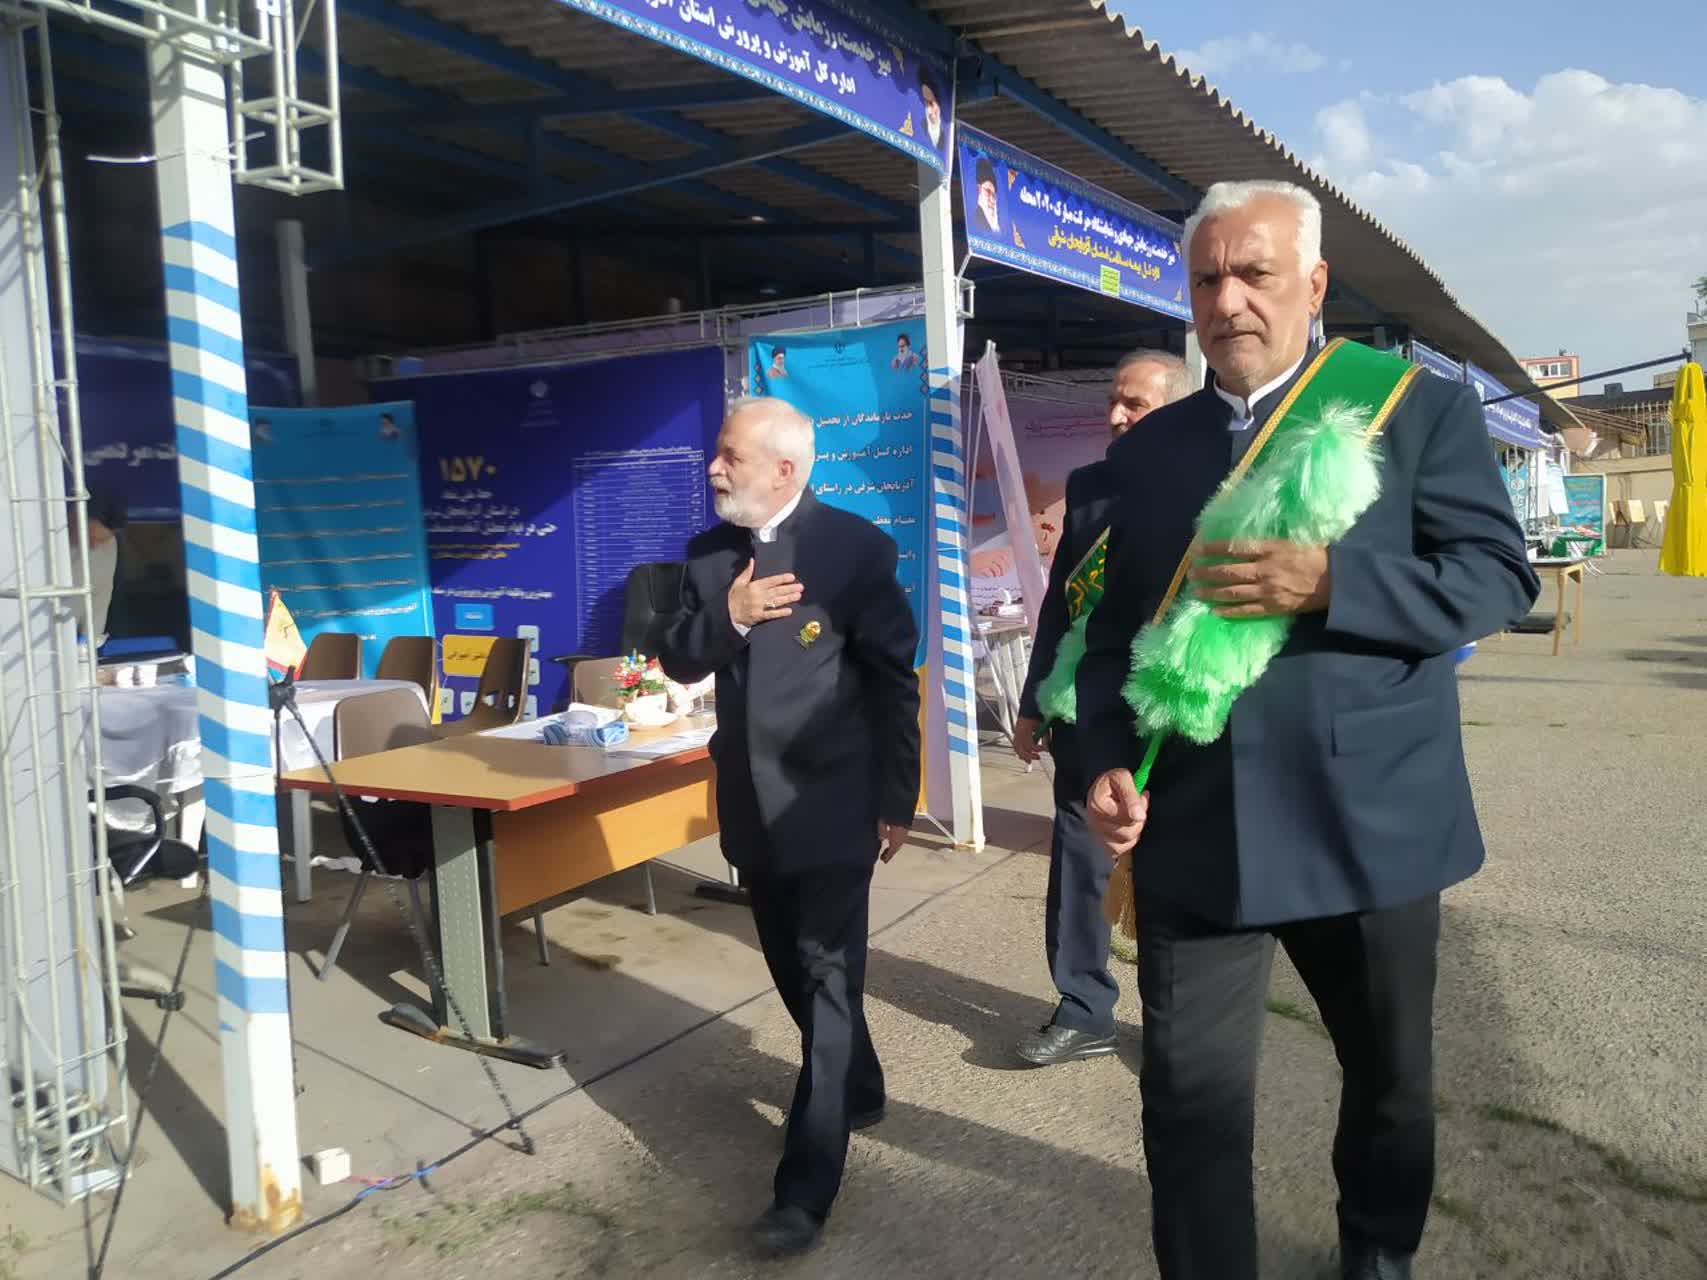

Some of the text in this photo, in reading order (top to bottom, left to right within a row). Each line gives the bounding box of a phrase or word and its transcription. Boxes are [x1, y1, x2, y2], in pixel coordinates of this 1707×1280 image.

[718, 15, 762, 56] پرورش
[763, 40, 771, 59] و
[773, 41, 811, 74] آموزش
[814, 60, 829, 83] کل
[831, 72, 857, 95] اداره
